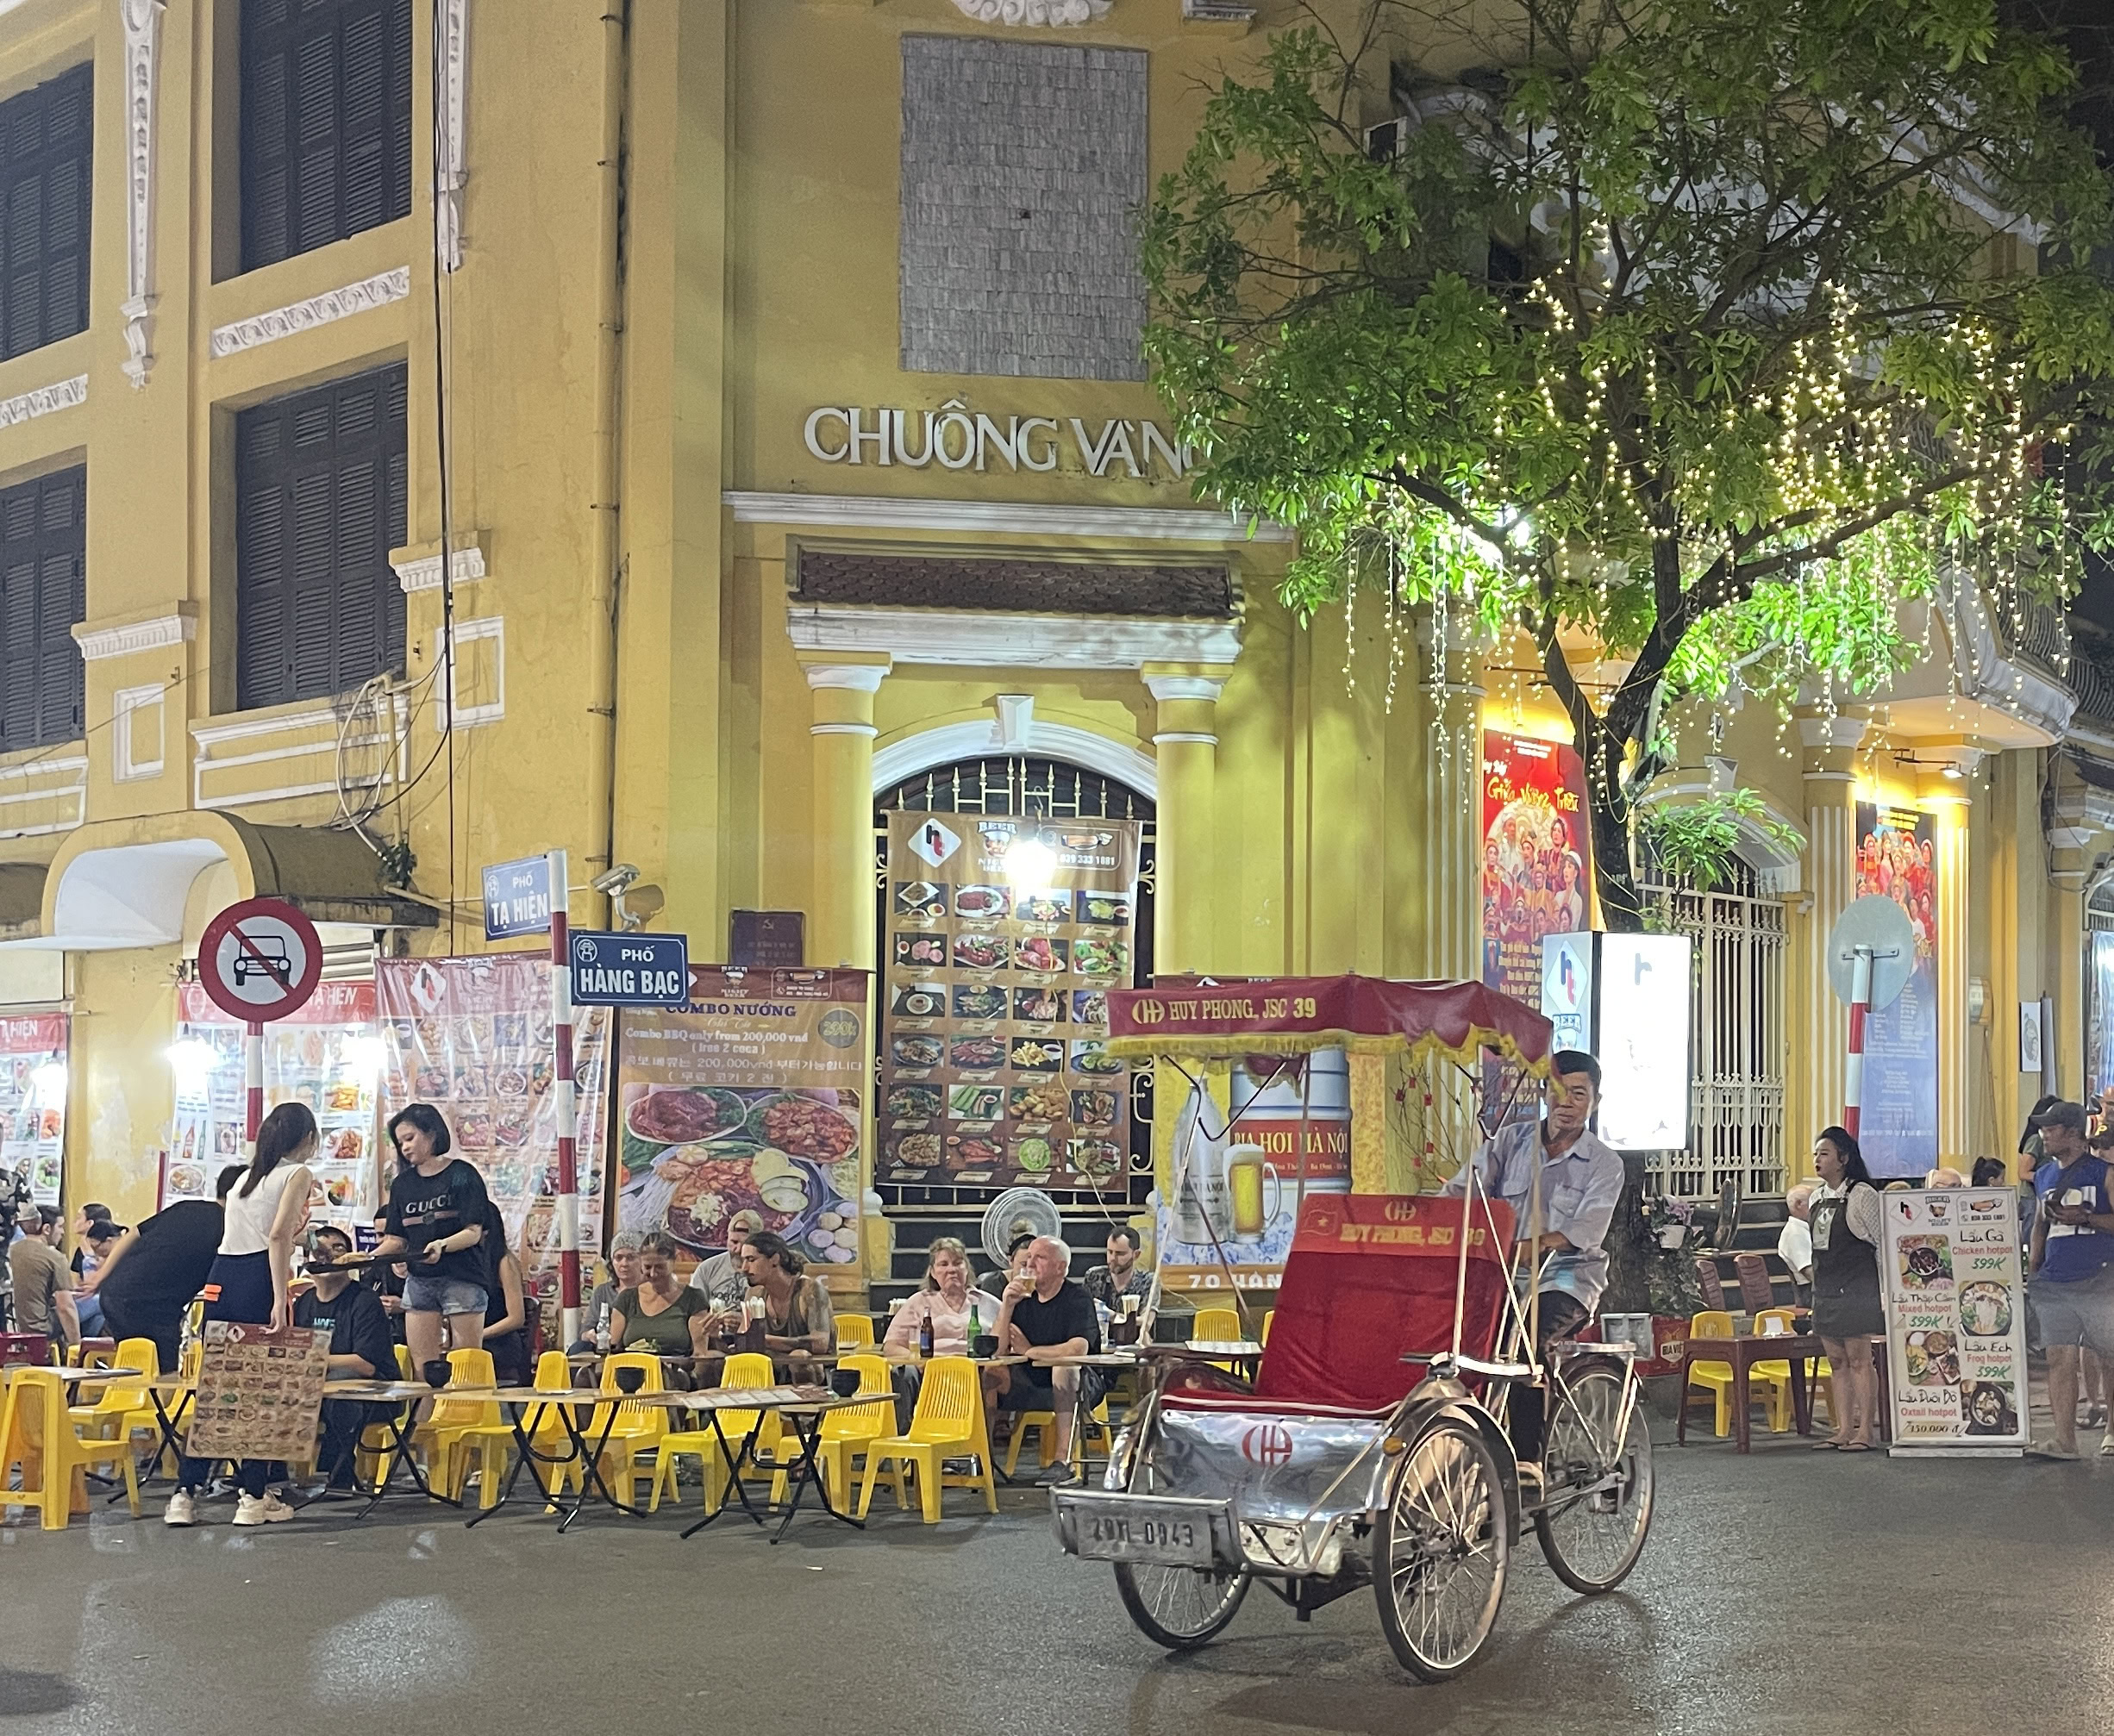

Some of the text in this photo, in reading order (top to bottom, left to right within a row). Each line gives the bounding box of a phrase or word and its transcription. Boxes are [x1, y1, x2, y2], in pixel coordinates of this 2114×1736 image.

[804, 399, 1059, 472] CHUÔNG
[978, 821, 1016, 834] BEER
[512, 870, 533, 889] PHỐ
[491, 890, 548, 929] TẠ HIỆN
[621, 945, 655, 963] PHỐ
[580, 963, 679, 999] HÀNG BẠC
[666, 1002, 730, 1015] COMBO
[733, 1001, 797, 1017] NƯỚNG
[1167, 1001, 1198, 1021] HUY
[1202, 999, 1259, 1021] PHONG,
[1262, 998, 1288, 1019] JSC
[1292, 997, 1317, 1019] 39
[625, 1027, 809, 1044] Combo BBQ only from 200,000 vnd
[1260, 1131, 1294, 1154] HƠI
[1327, 1127, 1348, 1159] NỘI
[405, 1194, 452, 1215] GUCCI
[1952, 1246, 2014, 1257] Chicken hotpot
[1972, 1257, 2007, 1271] 399K
[1188, 1271, 1283, 1289] 70 HÀN
[1898, 1302, 1952, 1314] Mixed hotpot
[1908, 1314, 1944, 1329] 399K
[1967, 1353, 2012, 1365] Frog hotpot
[1975, 1364, 2011, 1380] 399K
[1900, 1407, 1958, 1418] Oxtail hotpot
